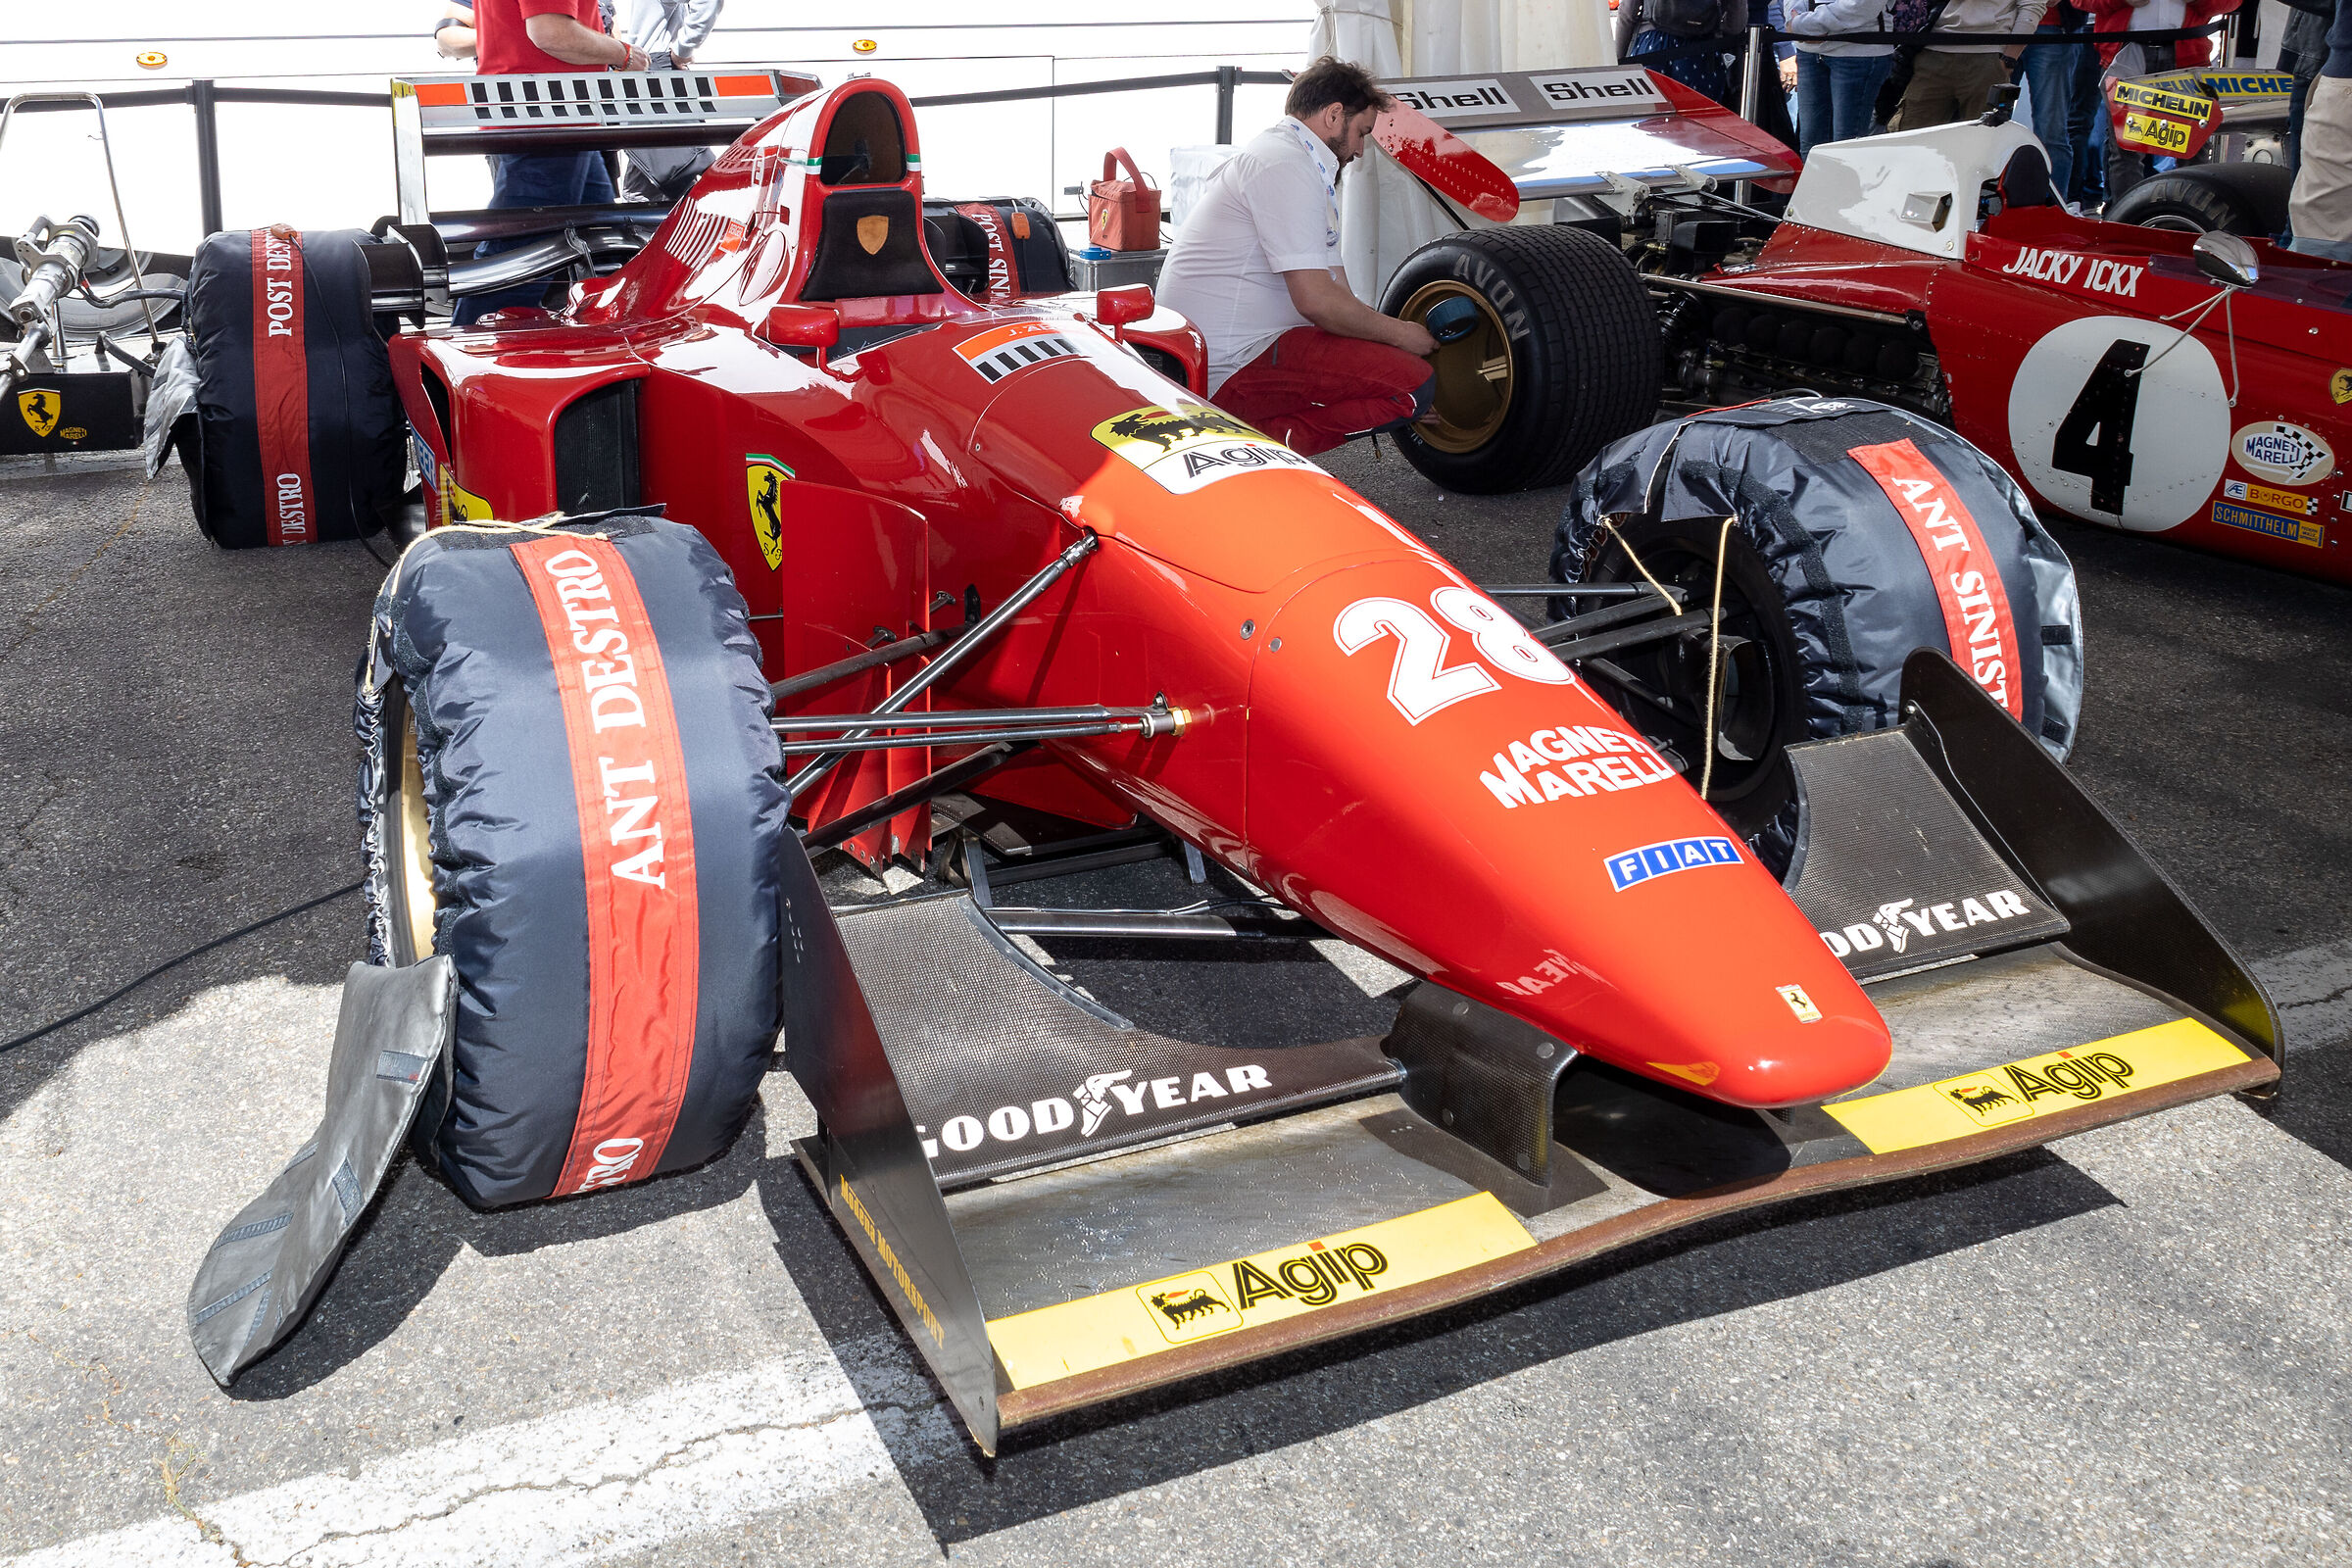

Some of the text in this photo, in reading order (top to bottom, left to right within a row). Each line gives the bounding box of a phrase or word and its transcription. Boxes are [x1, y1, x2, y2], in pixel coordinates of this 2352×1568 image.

[1394, 77, 1654, 111] Shell Shell
[2116, 85, 2210, 118] MICHELIN
[2209, 76, 2294, 94] MICHE
[2144, 120, 2186, 148] Agip
[1452, 253, 1532, 342] AVON
[2002, 246, 2144, 298] JACKY ICKX
[267, 277, 294, 338] POST
[2051, 338, 2151, 516] 4
[2245, 436, 2300, 455] MAGNETI
[1182, 442, 1308, 479] Agip
[2245, 446, 2300, 465] MARELLI
[276, 472, 307, 535] DESTRO
[2215, 506, 2298, 538] SCHMITTHELM
[2248, 488, 2305, 510] BORGO
[1890, 476, 2010, 710] ANT SINIST
[1333, 586, 1577, 727] 28
[545, 549, 666, 890] ANT DESTRO
[1482, 742, 1677, 809] MARELLI
[1617, 840, 1732, 883] FIAT
[1899, 888, 2032, 938] YEAR
[2002, 1051, 2135, 1102] Agip
[839, 1173, 946, 1350] Modena MOTORSPORT
[1231, 1240, 1389, 1307] Agip
